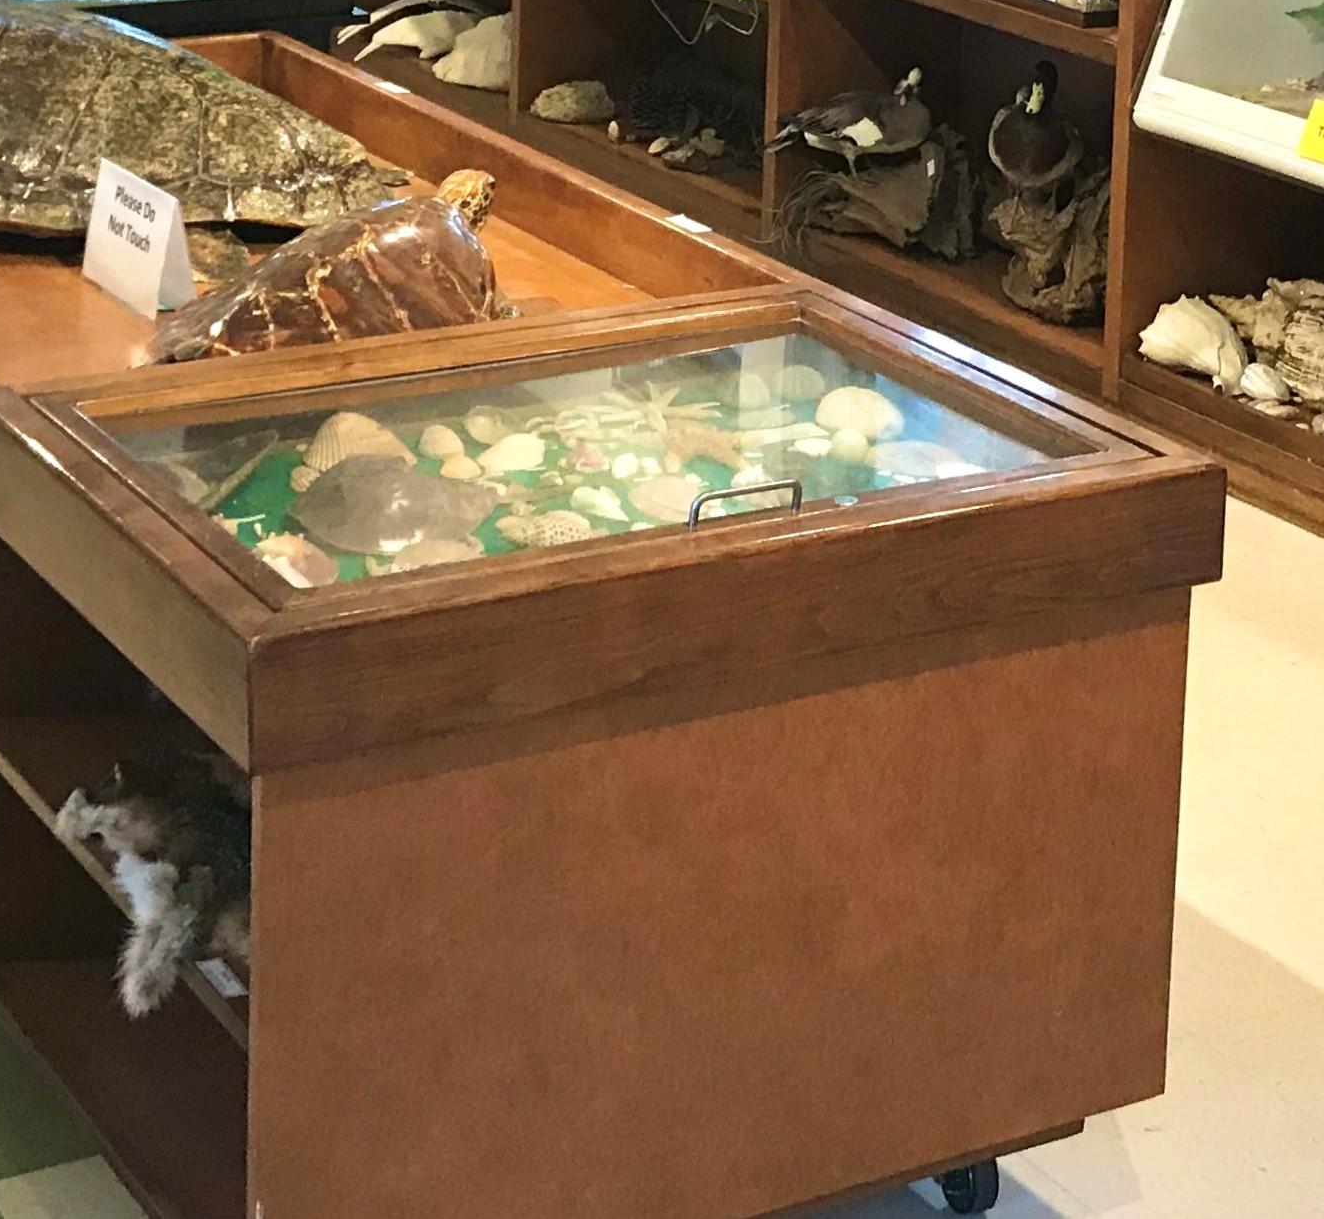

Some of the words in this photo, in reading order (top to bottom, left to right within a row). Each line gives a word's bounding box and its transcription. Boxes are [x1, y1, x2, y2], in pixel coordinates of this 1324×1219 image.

[114, 185, 143, 214] Please
[143, 201, 156, 223] Do
[107, 213, 126, 238] Not
[126, 224, 152, 253] Touch
